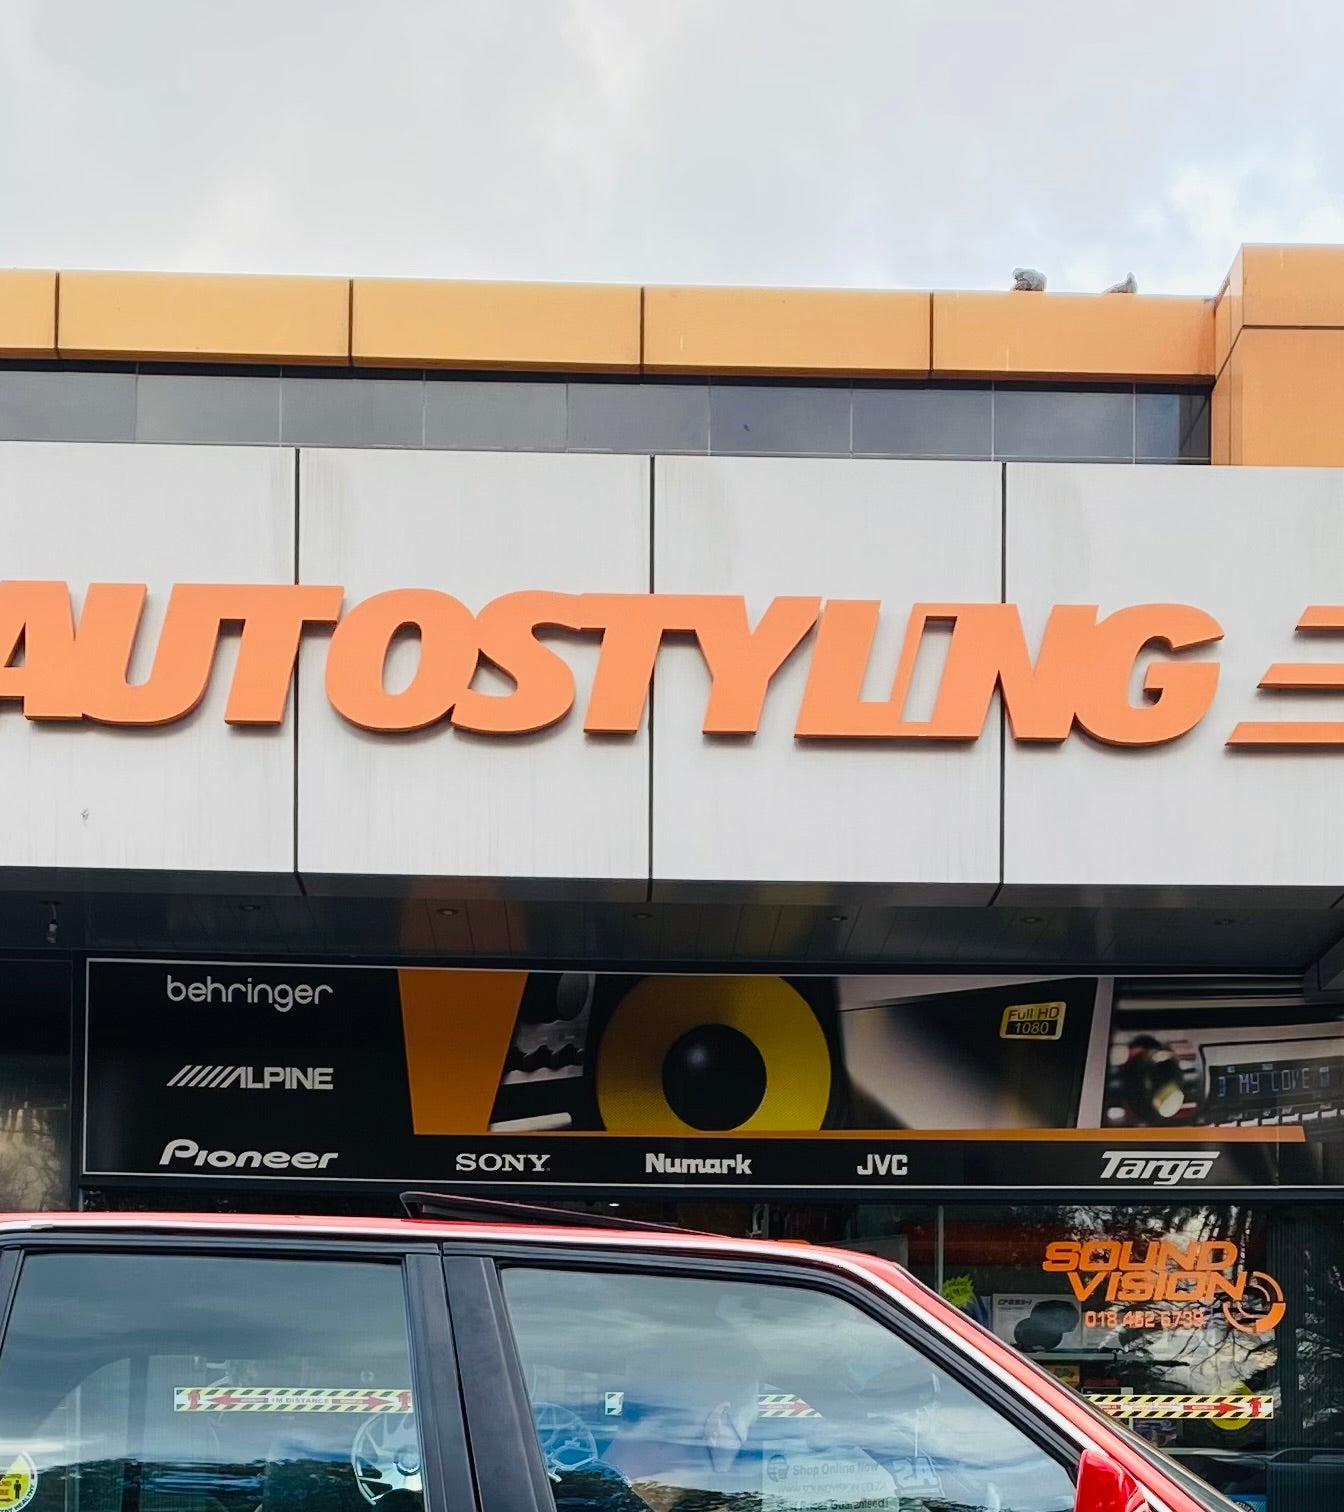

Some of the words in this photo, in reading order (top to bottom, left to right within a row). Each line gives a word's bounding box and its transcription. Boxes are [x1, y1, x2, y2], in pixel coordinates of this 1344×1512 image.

[166, 974, 334, 1013] behringer
[1008, 1008, 1034, 1021] Full
[1037, 1006, 1061, 1020] HD
[1013, 1021, 1050, 1035] 1080
[219, 1064, 334, 1090] ALPINE
[159, 1138, 339, 1170] Pioneer
[455, 1153, 547, 1173] SONY
[645, 1152, 753, 1175] Numark
[856, 1154, 909, 1177] JVC
[1100, 1150, 1221, 1186] Targa
[1042, 1240, 1238, 1272] SOUND
[1067, 1270, 1248, 1303] VISION
[1084, 1310, 1118, 1328] 018
